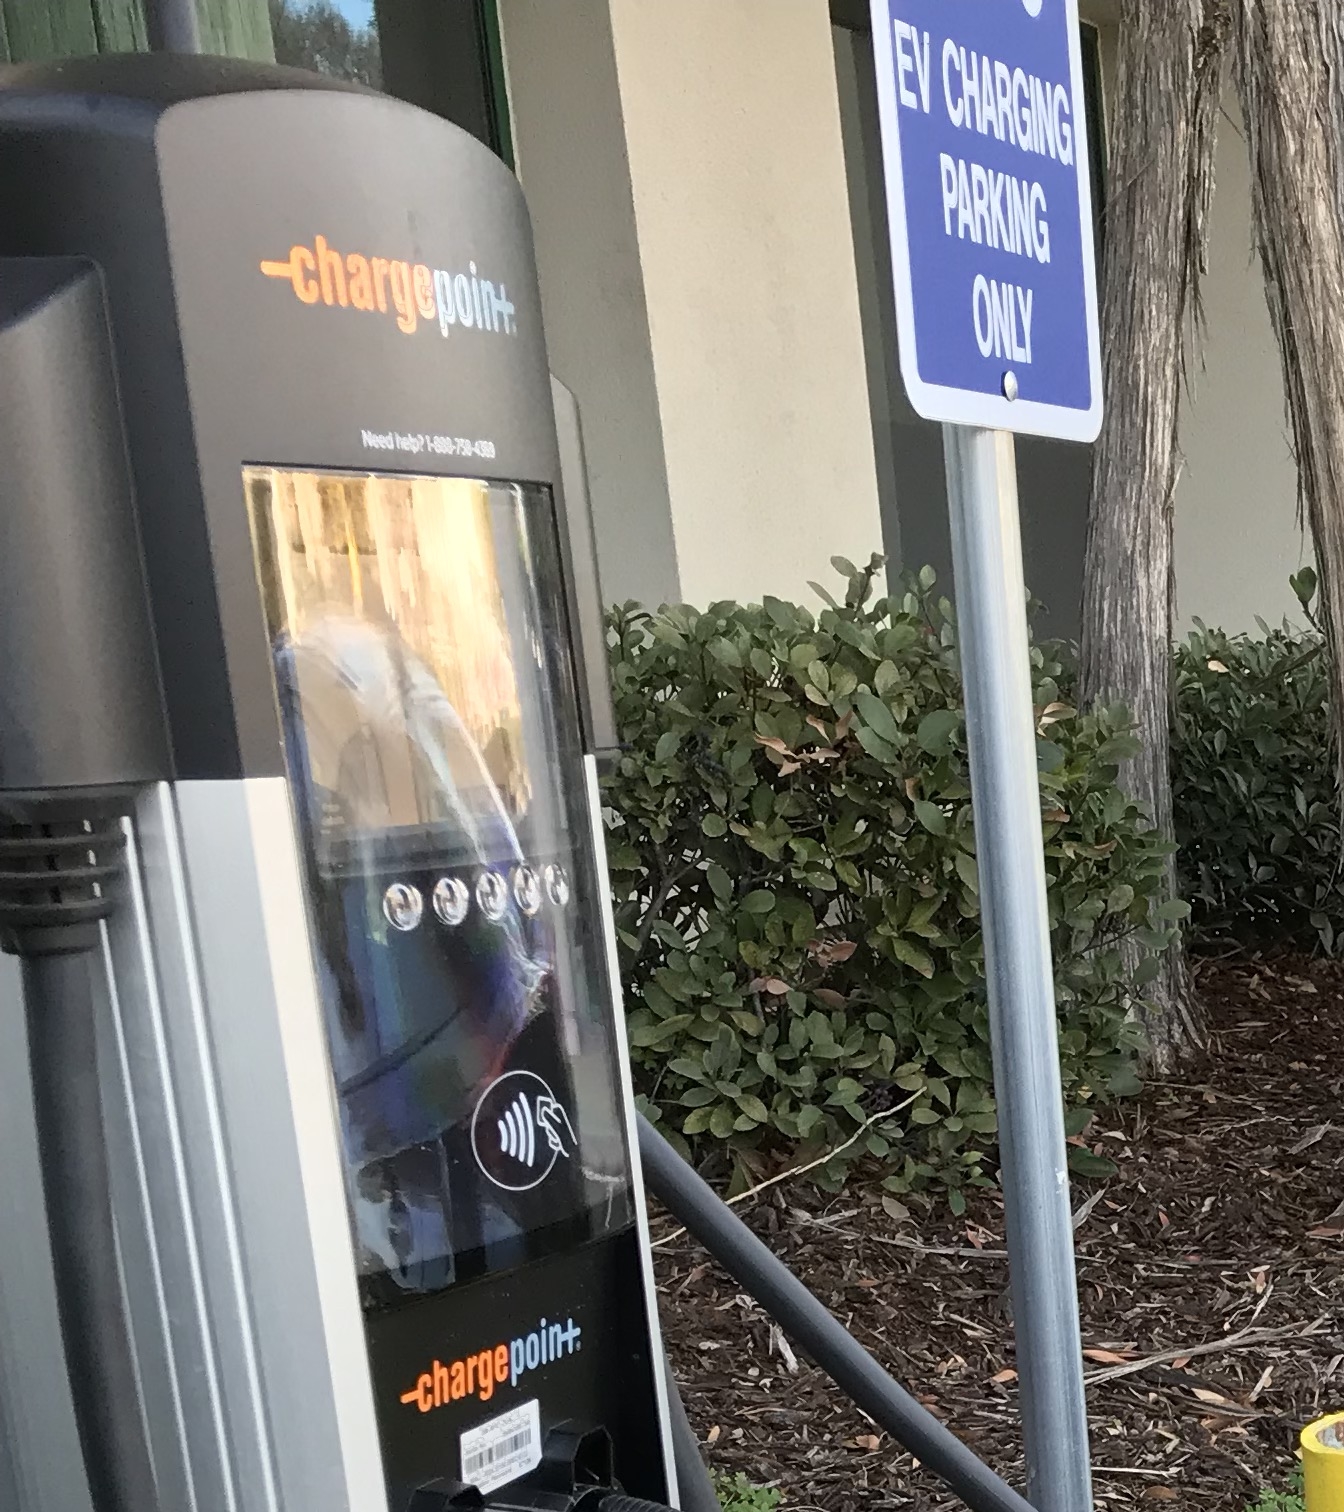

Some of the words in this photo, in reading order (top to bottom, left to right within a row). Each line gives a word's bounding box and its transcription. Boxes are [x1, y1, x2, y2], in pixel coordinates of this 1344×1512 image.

[894, 19, 930, 114] EV
[942, 38, 1073, 166] CHARGING
[940, 152, 1050, 264] PARKING
[972, 273, 1033, 364] ONLY
[360, 429, 394, 450] Need
[394, 431, 424, 454] help?
